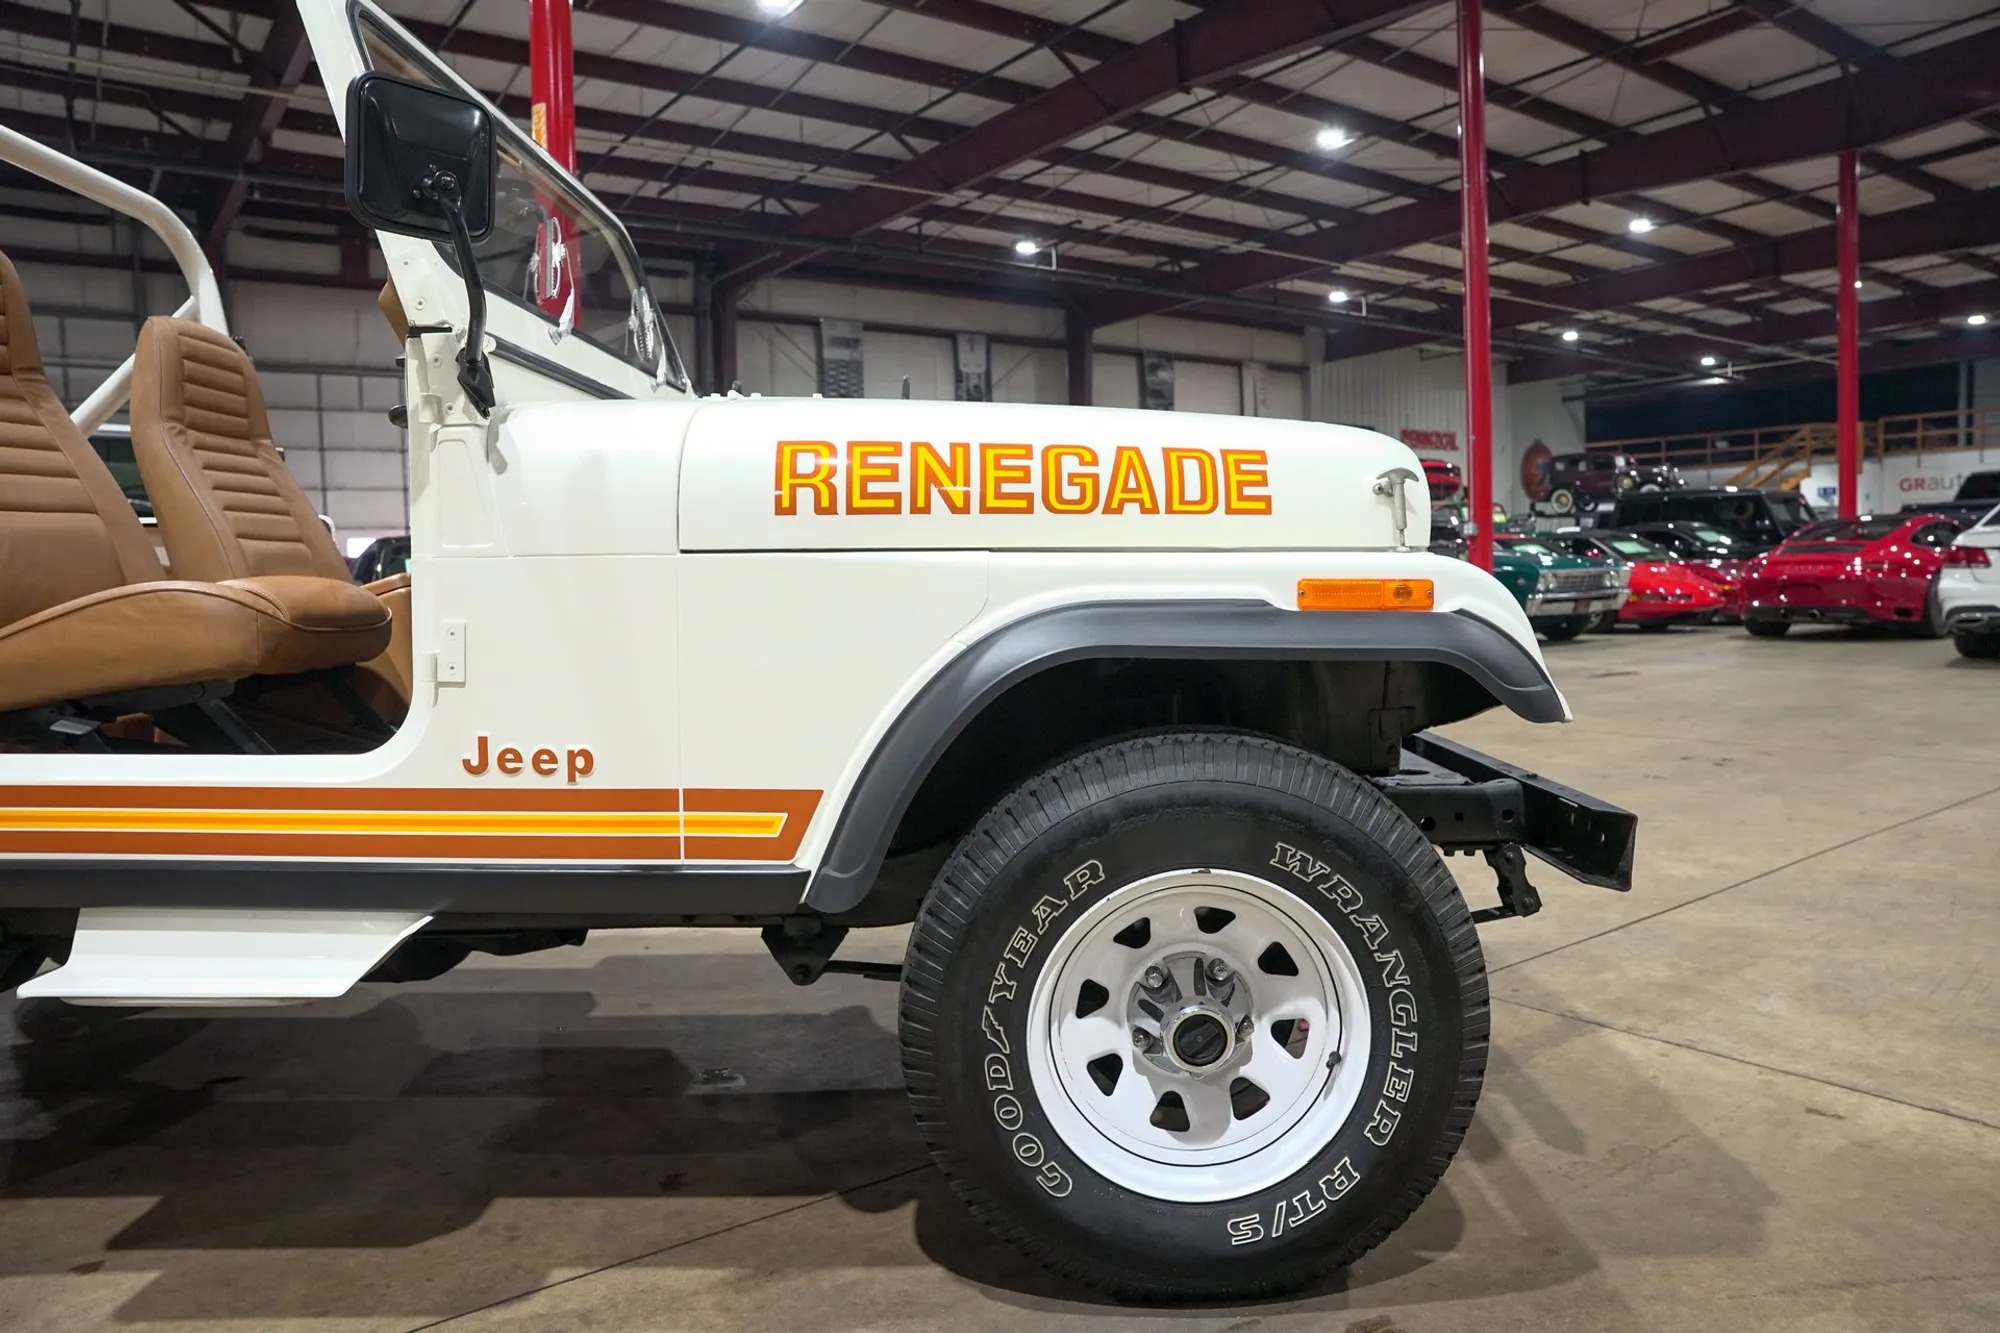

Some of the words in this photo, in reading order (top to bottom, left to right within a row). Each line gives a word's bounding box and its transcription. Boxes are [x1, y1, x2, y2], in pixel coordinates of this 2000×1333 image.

[774, 440, 1273, 516] RENEGADE
[462, 735, 594, 783] Jeep
[1270, 842, 1418, 1146] WRANGLER
[1228, 1157, 1362, 1245] RT/S
